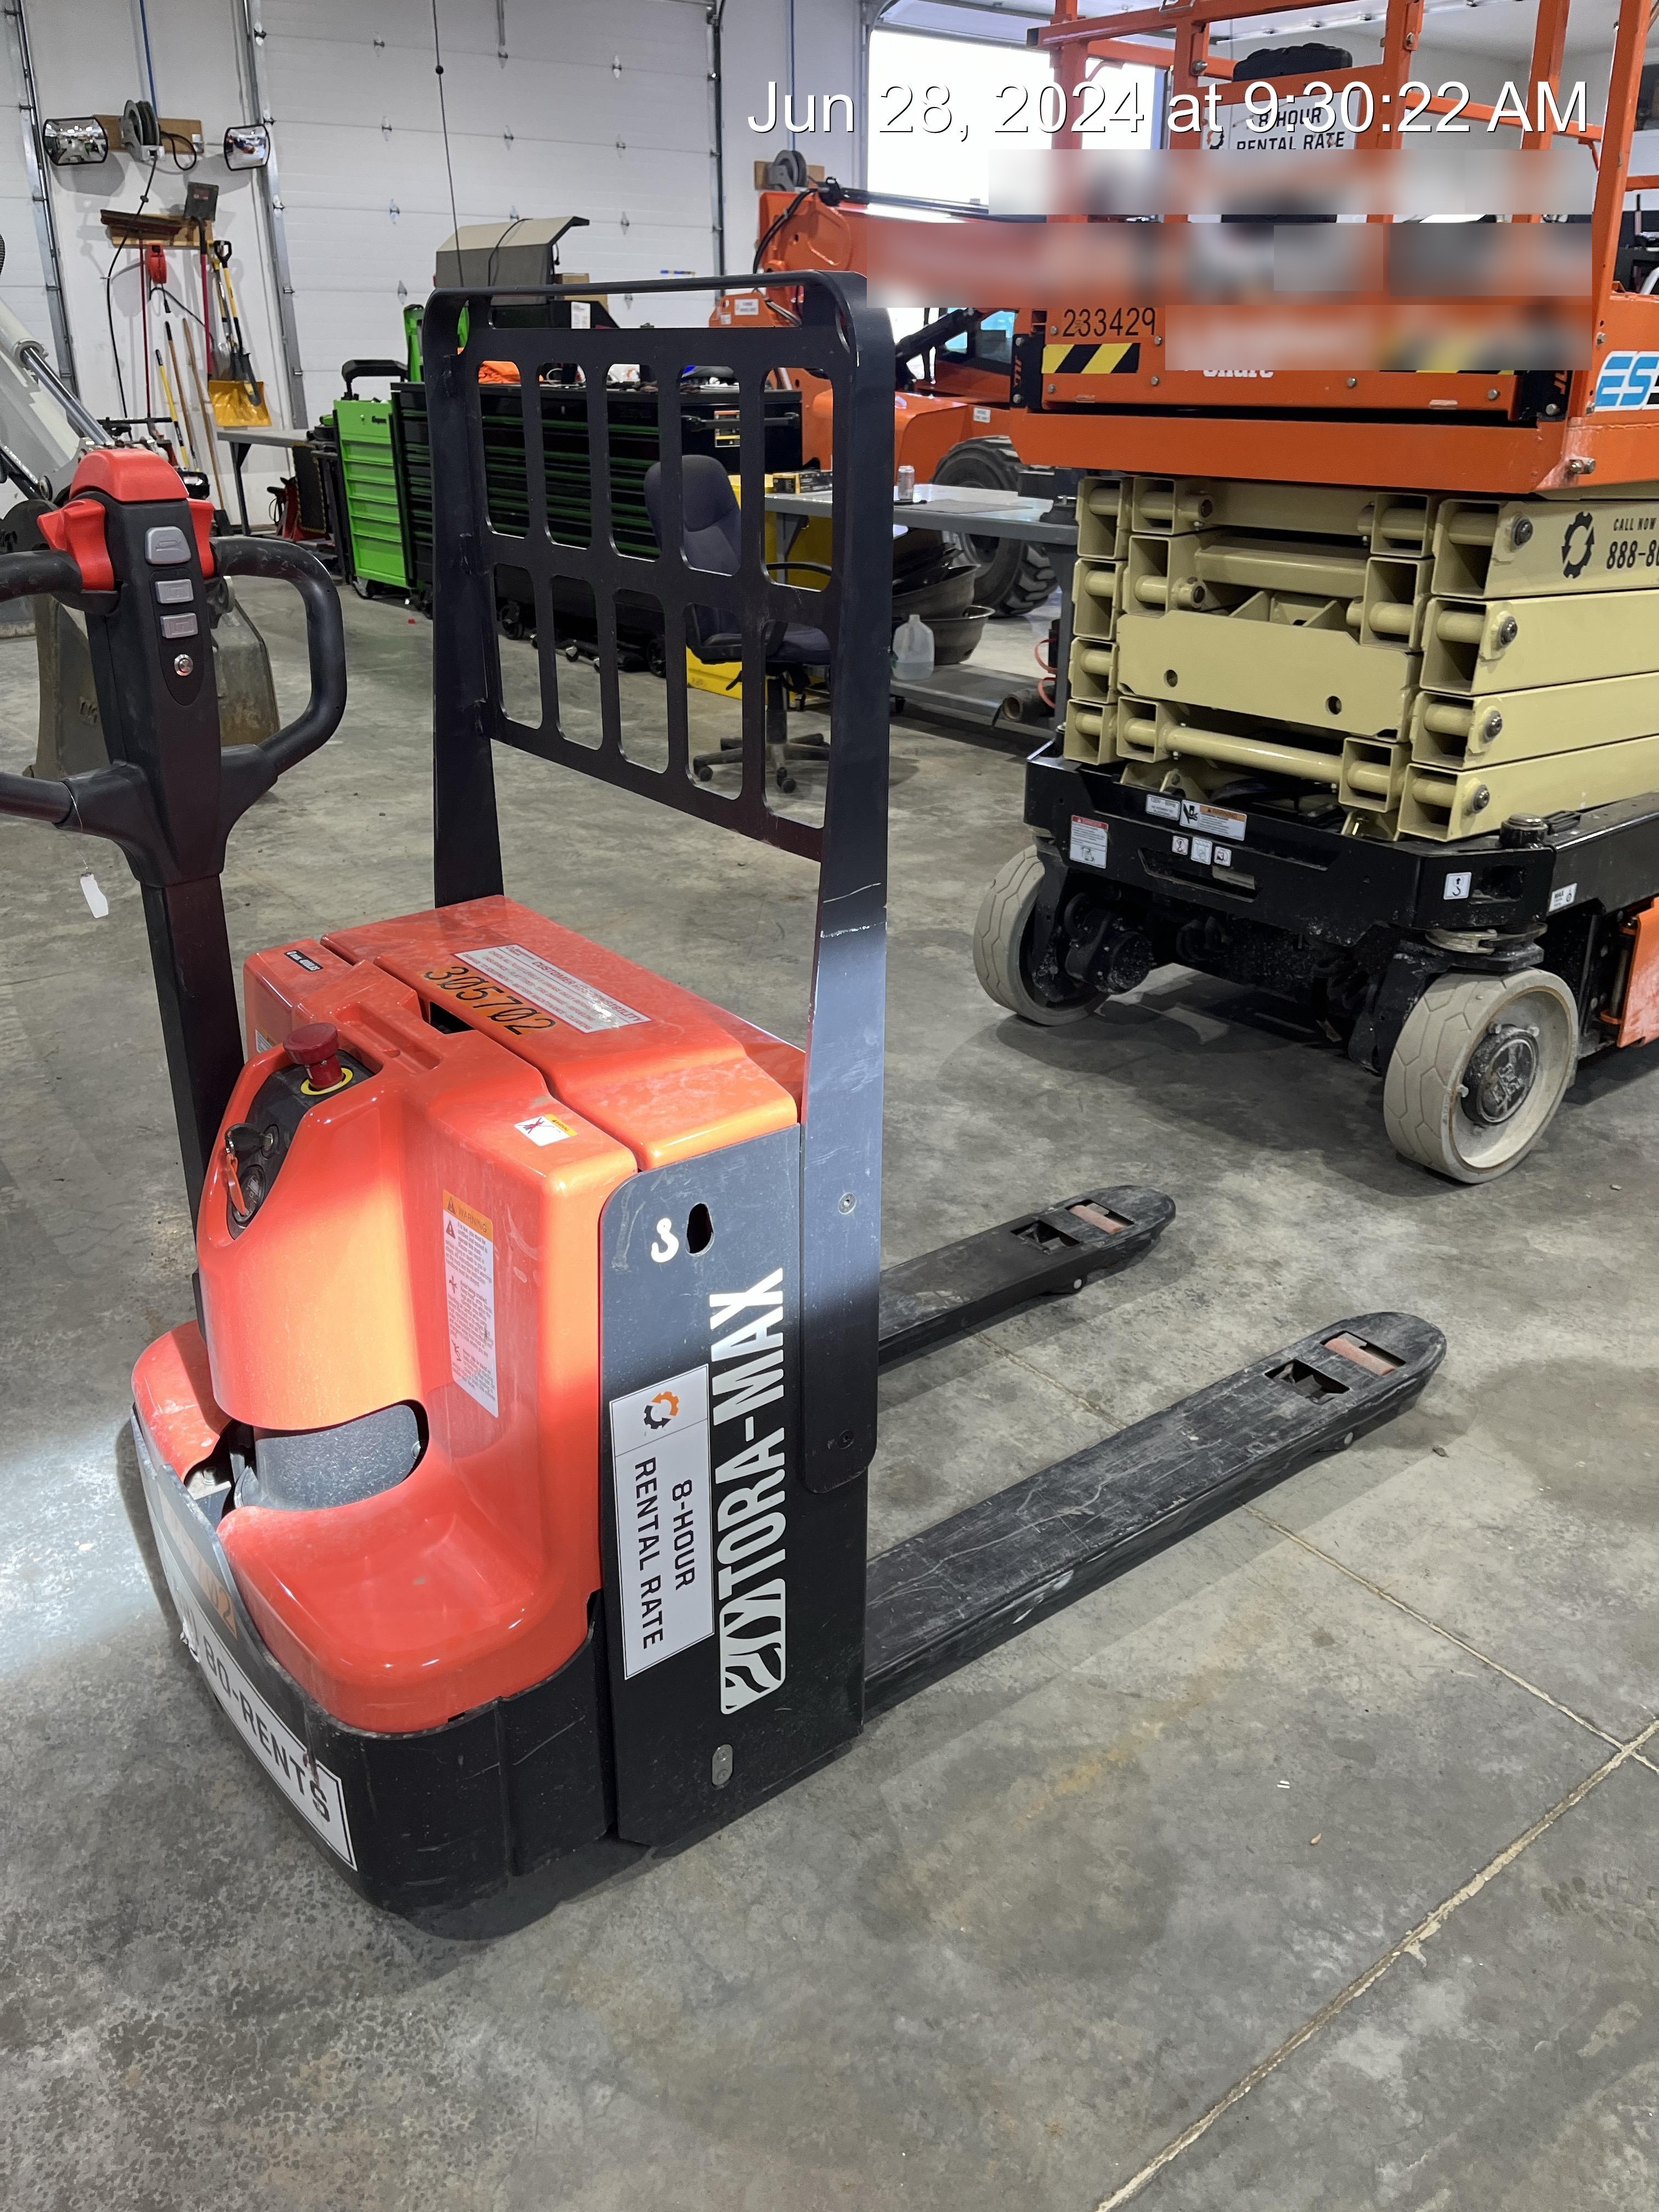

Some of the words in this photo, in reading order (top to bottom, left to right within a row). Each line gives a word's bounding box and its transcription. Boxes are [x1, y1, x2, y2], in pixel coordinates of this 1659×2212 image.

[1304, 131, 1345, 150] RATE
[1062, 307, 1156, 337] 233429
[1595, 357, 1659, 407] ES
[1613, 518, 1634, 531] CALL
[531, 962, 576, 988] CUSTOMER
[424, 966, 556, 1036] 305702
[458, 1207, 487, 1233] WARNING
[709, 1268, 786, 1600] TORA-MAX
[635, 1457, 660, 1571] RENTAL
[672, 1479, 695, 1590] 8-HOUR
[640, 1575, 664, 1650] RATE
